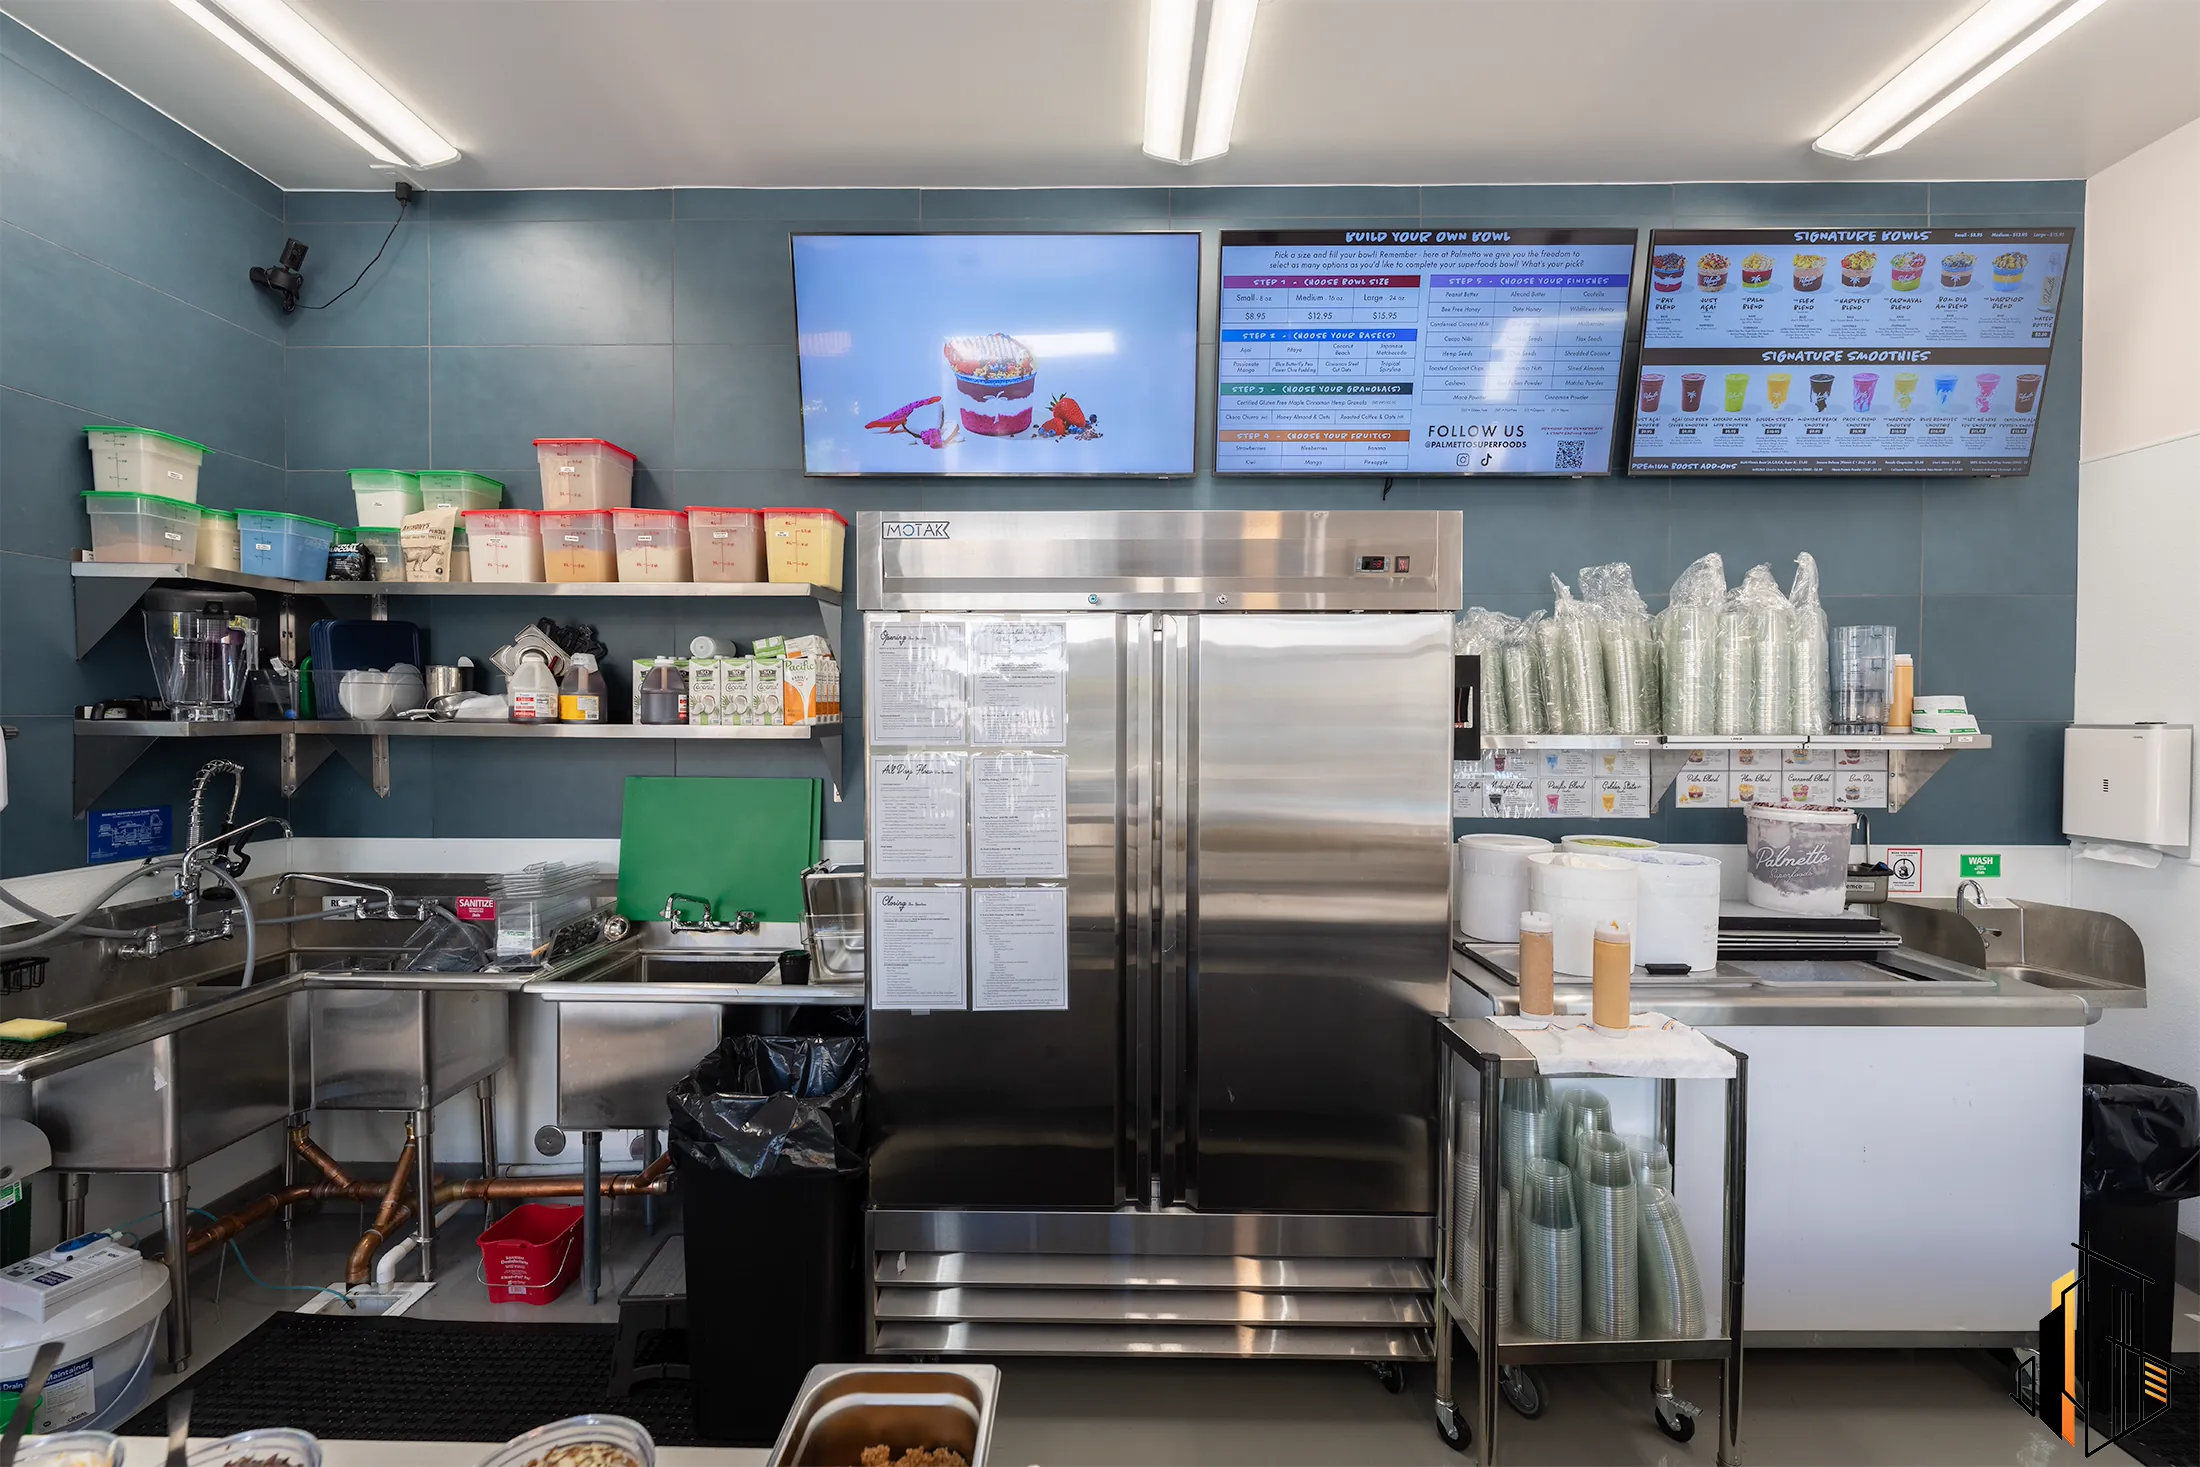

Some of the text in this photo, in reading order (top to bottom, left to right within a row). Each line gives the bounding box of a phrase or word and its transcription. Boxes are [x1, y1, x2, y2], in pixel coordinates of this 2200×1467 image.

[1345, 231, 1511, 244] BUILD YOUR OWN BOWL
[1793, 230, 1932, 243] SIGNATURE BOWLS
[1274, 250, 1289, 259] Pick
[1298, 251, 1311, 259] size
[1312, 250, 1327, 259] and
[1328, 250, 1338, 259] fill
[1339, 252, 1356, 261] your
[1358, 250, 1378, 259] bowl!
[1380, 250, 1417, 259] Remember
[1423, 250, 1439, 258] here
[1450, 250, 1482, 258] Palmetto
[1495, 251, 1511, 260] give
[1512, 252, 1526, 260] you
[1528, 250, 1541, 258] the
[1542, 250, 1571, 258] freedom
[1269, 261, 1290, 269] select
[1322, 261, 1349, 270] options
[1359, 261, 1380, 270] you'd
[1382, 260, 1397, 269] like
[1405, 260, 1438, 270] complete
[1439, 262, 1456, 270] your
[1457, 260, 1498, 270] superfoods
[1499, 260, 1519, 268] bowl!
[1521, 260, 1545, 268] What's
[1546, 262, 1564, 270] your
[1564, 260, 1584, 270] pick?
[1253, 278, 1278, 286] STEP
[1303, 278, 1338, 286] CHOOSE
[1341, 278, 1366, 286] BOWL
[1368, 278, 1390, 286] SIZE
[1448, 277, 1472, 285] STEP
[1500, 277, 1535, 285] CHOOSE
[1538, 277, 1564, 285] YOUR
[1566, 277, 1610, 285] FINISHES
[1236, 294, 1256, 302] Small
[1295, 294, 1324, 302] Medium
[1363, 293, 1384, 302] Large
[1245, 312, 1266, 320] $8.95
[1307, 311, 1333, 320] $12.95
[1372, 311, 1398, 320] $15.95
[1242, 332, 1267, 340] STEP
[1293, 332, 1328, 340] CHOOSE
[1330, 332, 1356, 340] YOUR
[1762, 350, 1932, 363] SIGNATURE SMOOTHIES
[1346, 385, 1401, 393] GRANOLA(S)
[1236, 432, 1260, 440] STEP
[1287, 432, 1320, 440] CHOOSE
[1323, 432, 1348, 440] YOUR
[1350, 432, 1392, 440] FRUIT(S)
[1428, 425, 1525, 437] FOLLOW US
[1424, 440, 1527, 449] @PALMETTOSUPERFOODS
[1631, 463, 1670, 471] PREMIUM
[886, 524, 944, 537] MOTAK
[880, 630, 907, 646] Opening
[784, 660, 815, 672] Pacific
[693, 682, 715, 692] Coconut
[725, 682, 748, 692] Coconut
[756, 682, 778, 692] Coconut
[881, 764, 896, 775] All
[896, 764, 914, 780] Day
[1686, 774, 1720, 783] Palm Blend
[1740, 774, 1773, 782] Flex Blend
[1787, 773, 1833, 783] Carnaval Blend
[1547, 780, 1587, 793] Pacific Blend
[1602, 781, 1623, 792] Golden
[1755, 844, 1830, 869] Palmetto
[1968, 857, 1993, 865] WASH
[1768, 868, 1813, 884] Superfoods
[459, 898, 494, 908] SANITIZE
[882, 895, 907, 912] Closing
[2, 1382, 24, 1390] Drain
